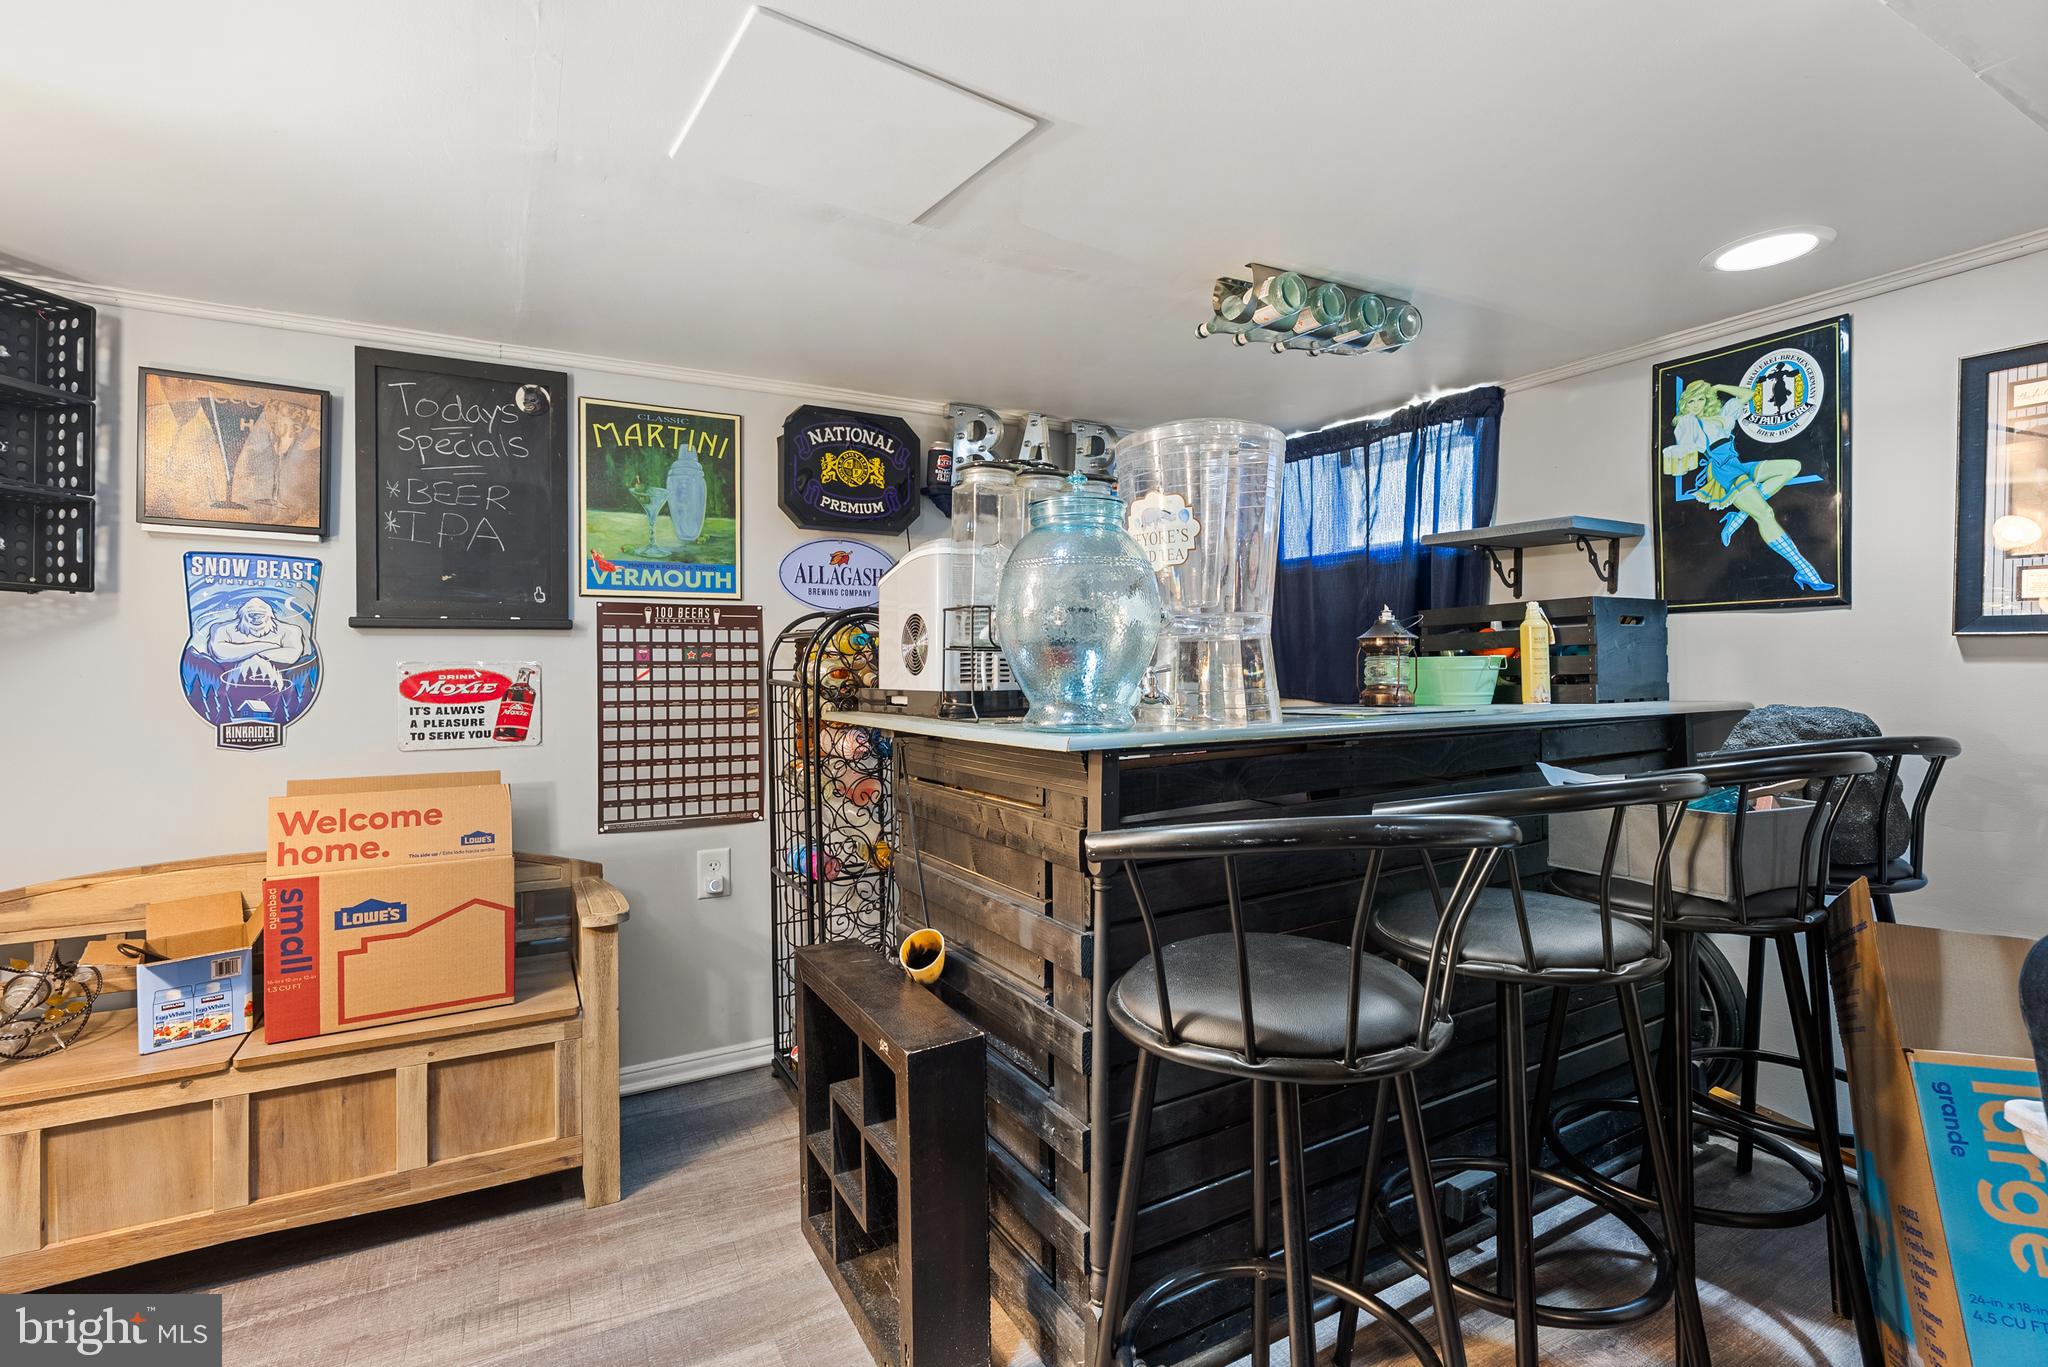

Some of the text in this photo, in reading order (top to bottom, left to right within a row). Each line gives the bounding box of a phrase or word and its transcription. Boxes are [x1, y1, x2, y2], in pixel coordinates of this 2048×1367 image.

[388, 382, 519, 433] Todays
[1759, 414, 1787, 426] PAULI
[1787, 403, 1811, 420] GIRL
[637, 413, 690, 425] CLASSIC
[1756, 422, 1800, 437] BIER BEER
[397, 427, 529, 464] Specials
[592, 422, 729, 459] MARTINI
[807, 426, 895, 455] NATIONAL
[407, 478, 510, 510] BEER
[820, 495, 885, 515] PREMIUM
[388, 511, 505, 551] IPA
[191, 556, 315, 581] SNOW BEAST
[590, 566, 732, 589] VERMOUTH
[794, 563, 884, 588] ALLAGASH
[204, 577, 303, 588] WINTER ALE
[808, 587, 872, 598] BREWING COMPANY
[655, 606, 710, 619] 100 BEERS
[409, 705, 485, 716] IT'S ALWAYS
[410, 718, 485, 728] A PLEASURE
[410, 730, 492, 741] TO SERVE YOU
[277, 808, 443, 837] Welcome
[464, 836, 492, 845] LOWE'S
[277, 841, 390, 867] home.
[267, 888, 280, 929] pequeña
[342, 907, 401, 927] LOWE'S
[280, 888, 312, 974] small
[279, 983, 291, 992] CU
[292, 982, 302, 990] FT
[168, 1010, 192, 1018] Whites
[1932, 1081, 1969, 1158] grande
[1969, 1293, 2003, 1308] 24-in
[1973, 1310, 1998, 1325] 4.5
[2001, 1315, 2027, 1330] CU
